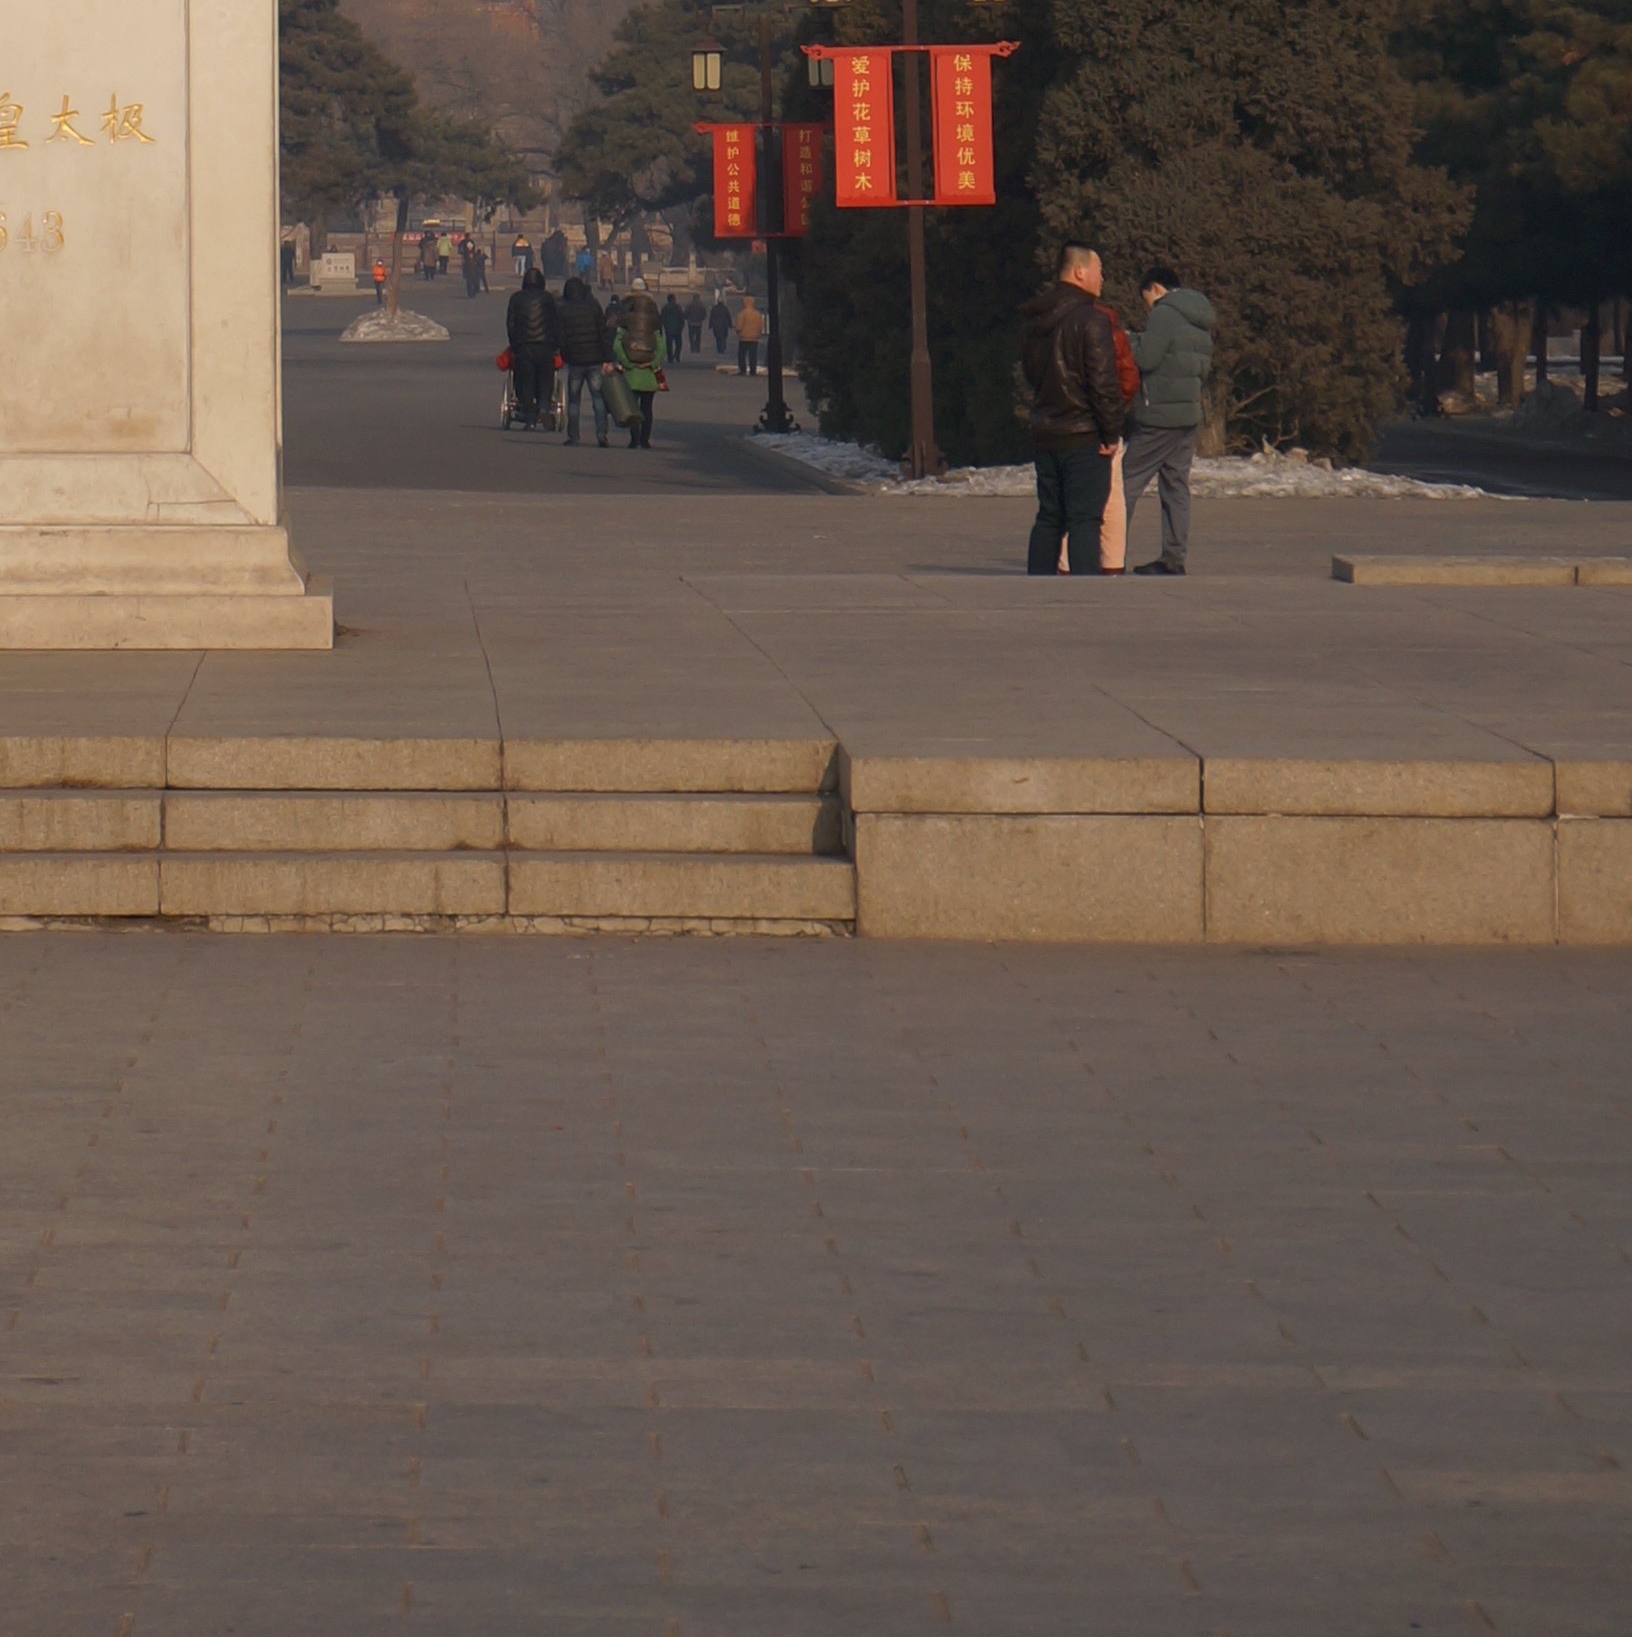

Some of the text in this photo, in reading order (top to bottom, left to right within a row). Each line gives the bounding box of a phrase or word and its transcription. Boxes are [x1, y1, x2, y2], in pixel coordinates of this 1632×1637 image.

[726, 130, 740, 226] 维护公共道德
[852, 55, 872, 190] 爱护花草树木
[954, 54, 976, 190] 保持环境优美
